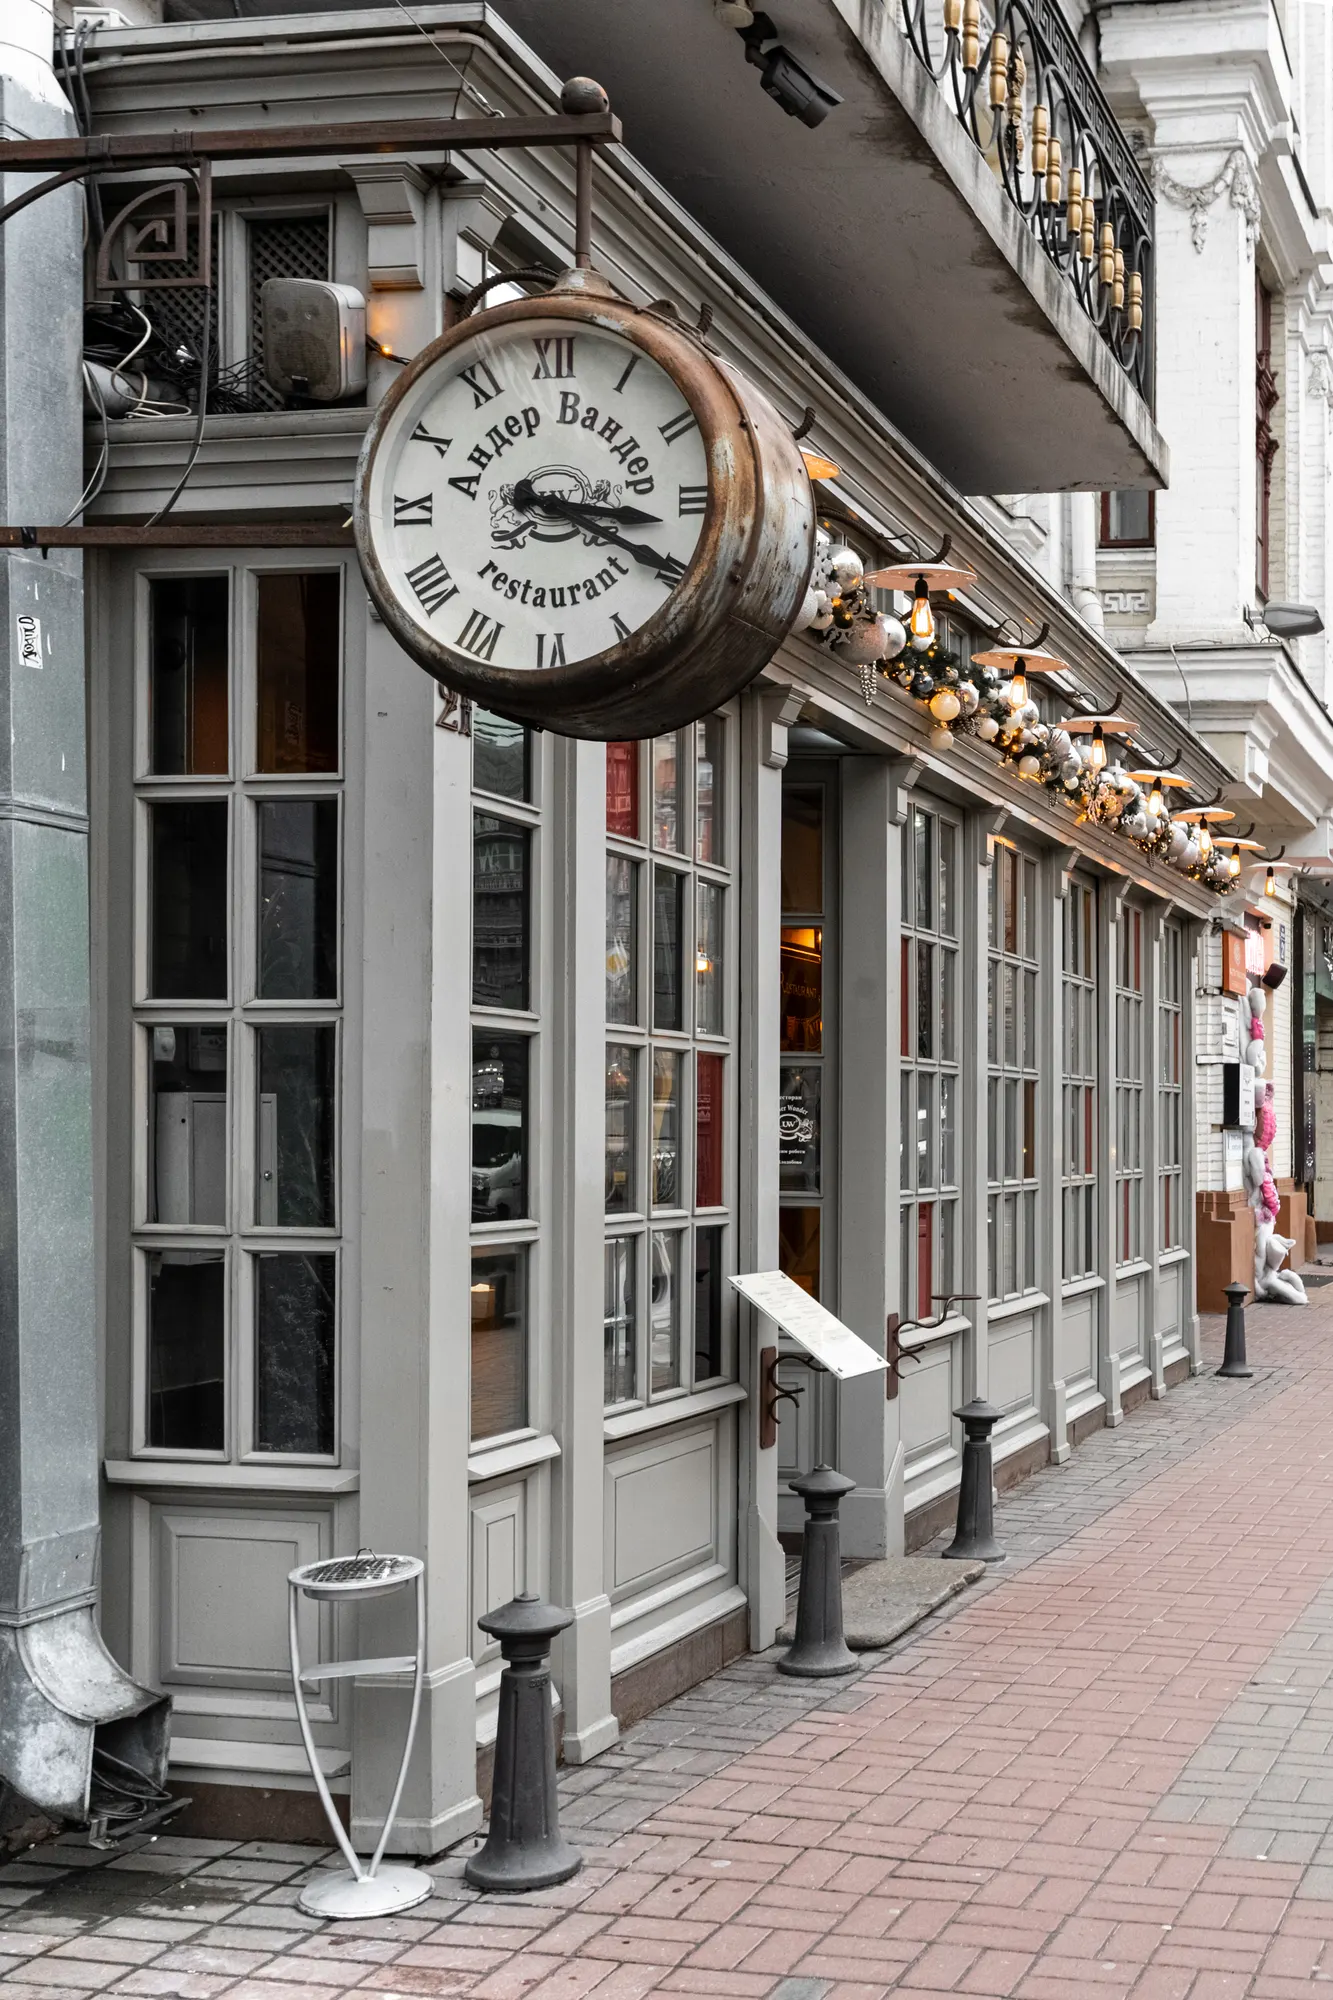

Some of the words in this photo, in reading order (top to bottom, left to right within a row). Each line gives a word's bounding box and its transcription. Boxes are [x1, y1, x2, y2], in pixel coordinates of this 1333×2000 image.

[531, 337, 576, 379] XII
[613, 353, 642, 394] I
[457, 359, 504, 409] XI
[409, 420, 453, 459] X
[448, 406, 541, 501] Андер
[556, 391, 654, 495] Вандер
[394, 492, 433, 528] IX
[477, 555, 629, 608] restaurant
